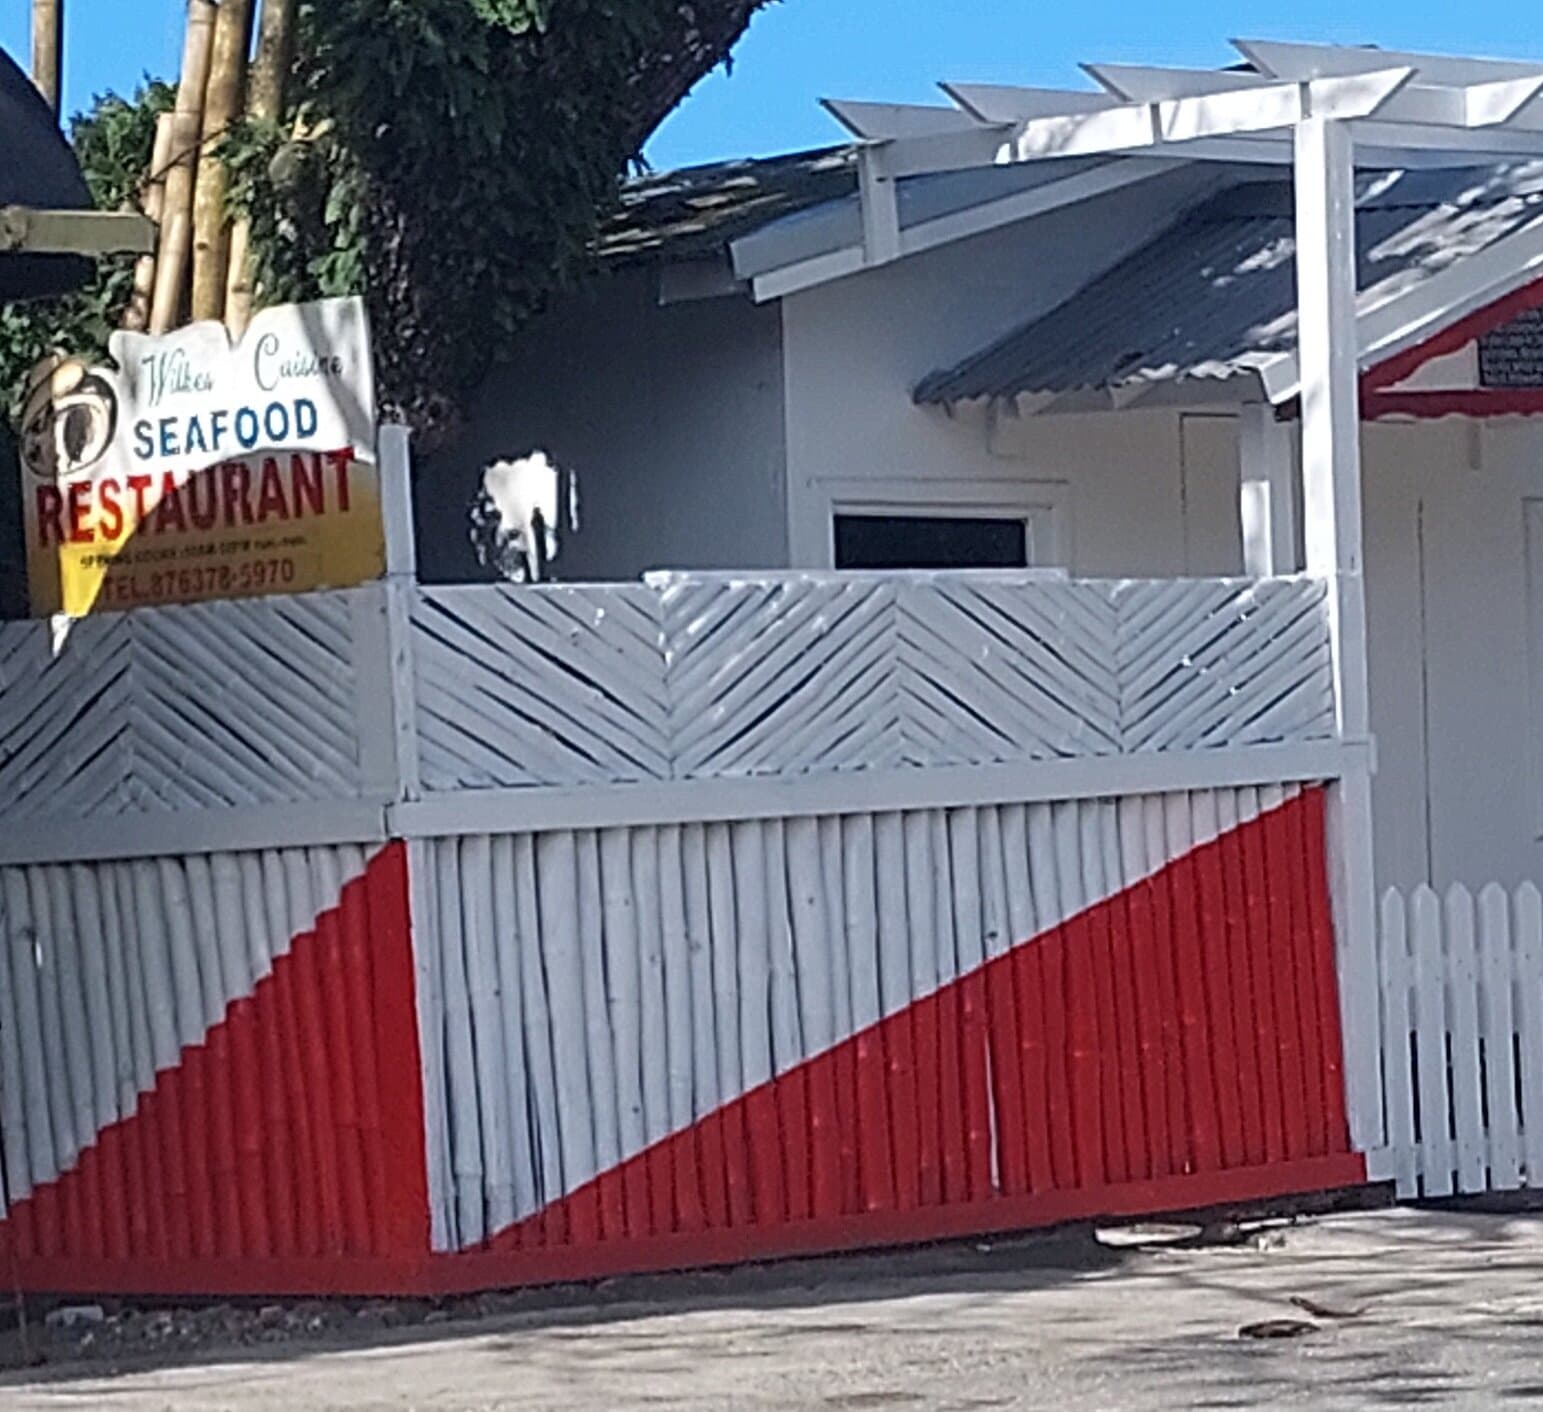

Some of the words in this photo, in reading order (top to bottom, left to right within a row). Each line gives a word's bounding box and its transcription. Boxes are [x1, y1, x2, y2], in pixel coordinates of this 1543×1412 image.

[253, 333, 343, 392] Cuisine
[133, 397, 319, 461] SEAFOOD
[35, 446, 356, 548] RESTAURANT
